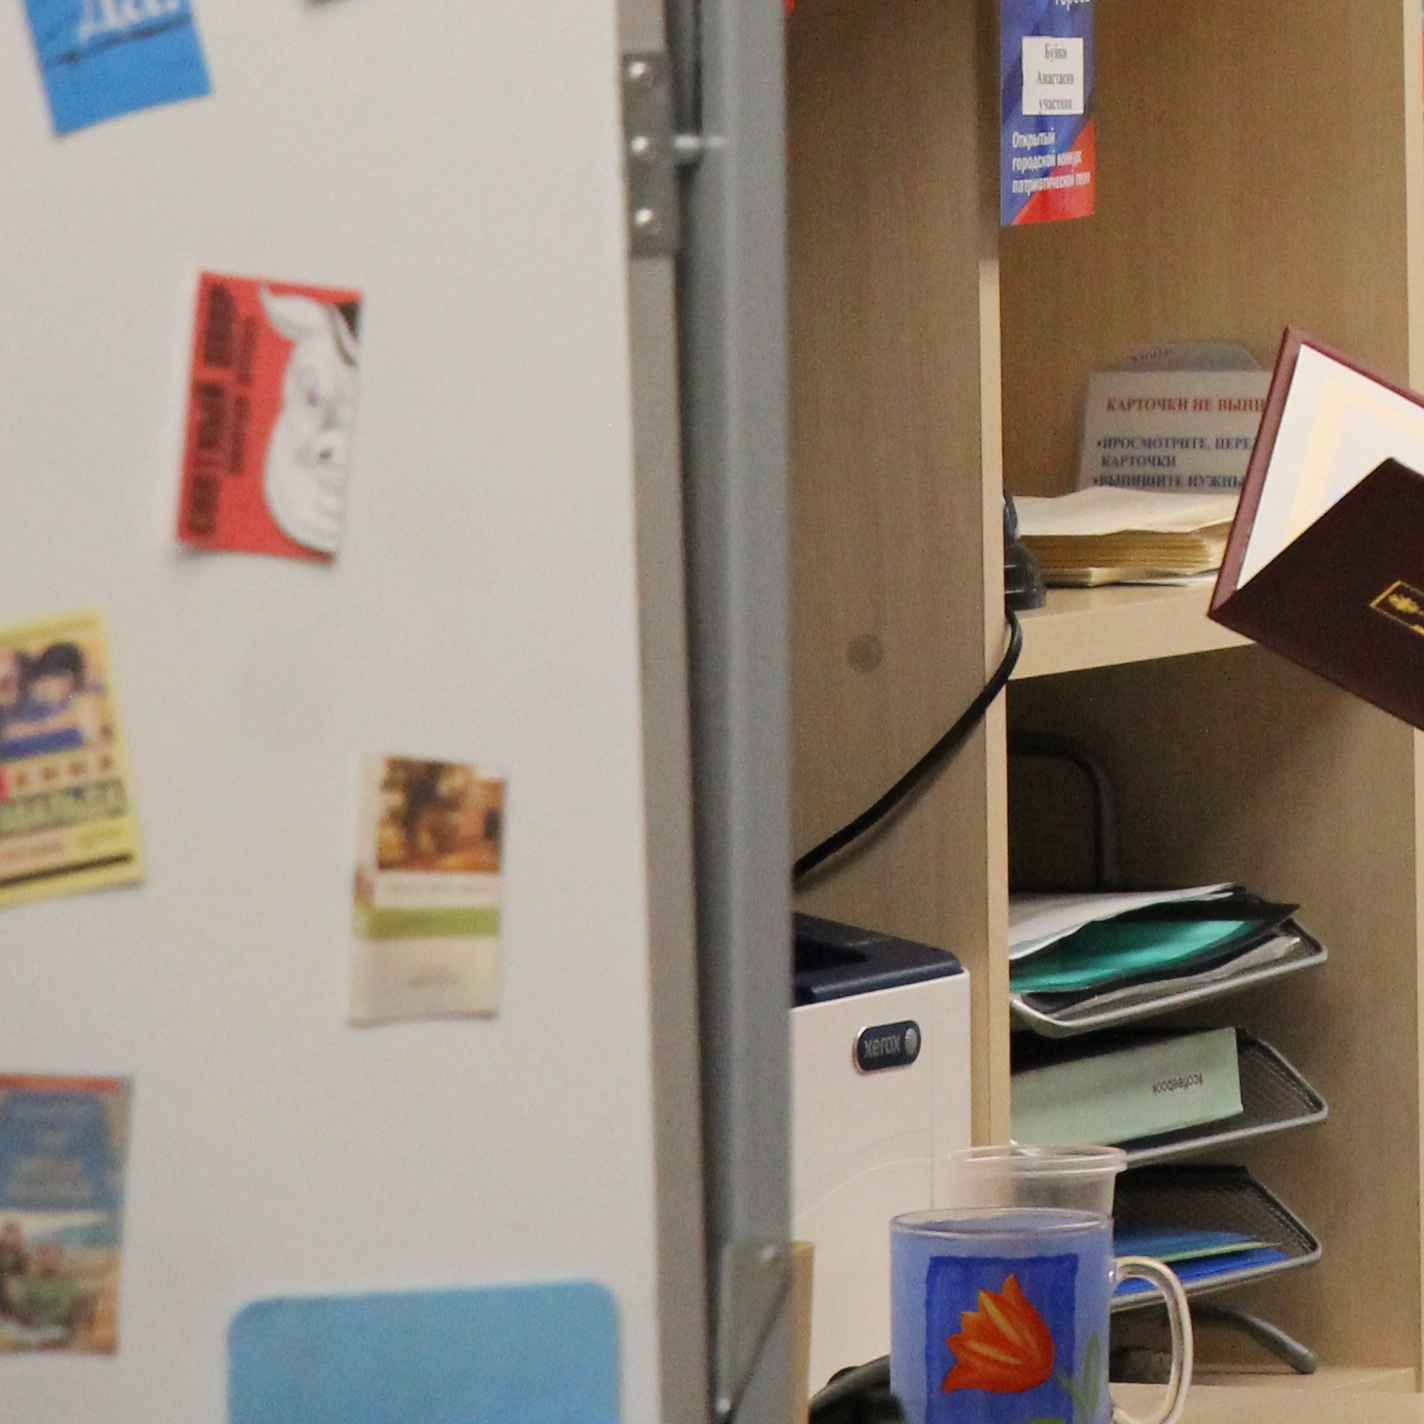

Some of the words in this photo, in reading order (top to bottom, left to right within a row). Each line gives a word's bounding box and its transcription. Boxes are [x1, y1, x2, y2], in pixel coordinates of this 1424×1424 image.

[1012, 127, 1056, 150] Открытый
[1012, 150, 1055, 172] городской
[1107, 398, 1188, 412] КАРТОЧКИ
[1194, 398, 1212, 412] НЕ
[1101, 455, 1176, 468] КАРТОЧКИ
[864, 1034, 901, 1058] xerox
